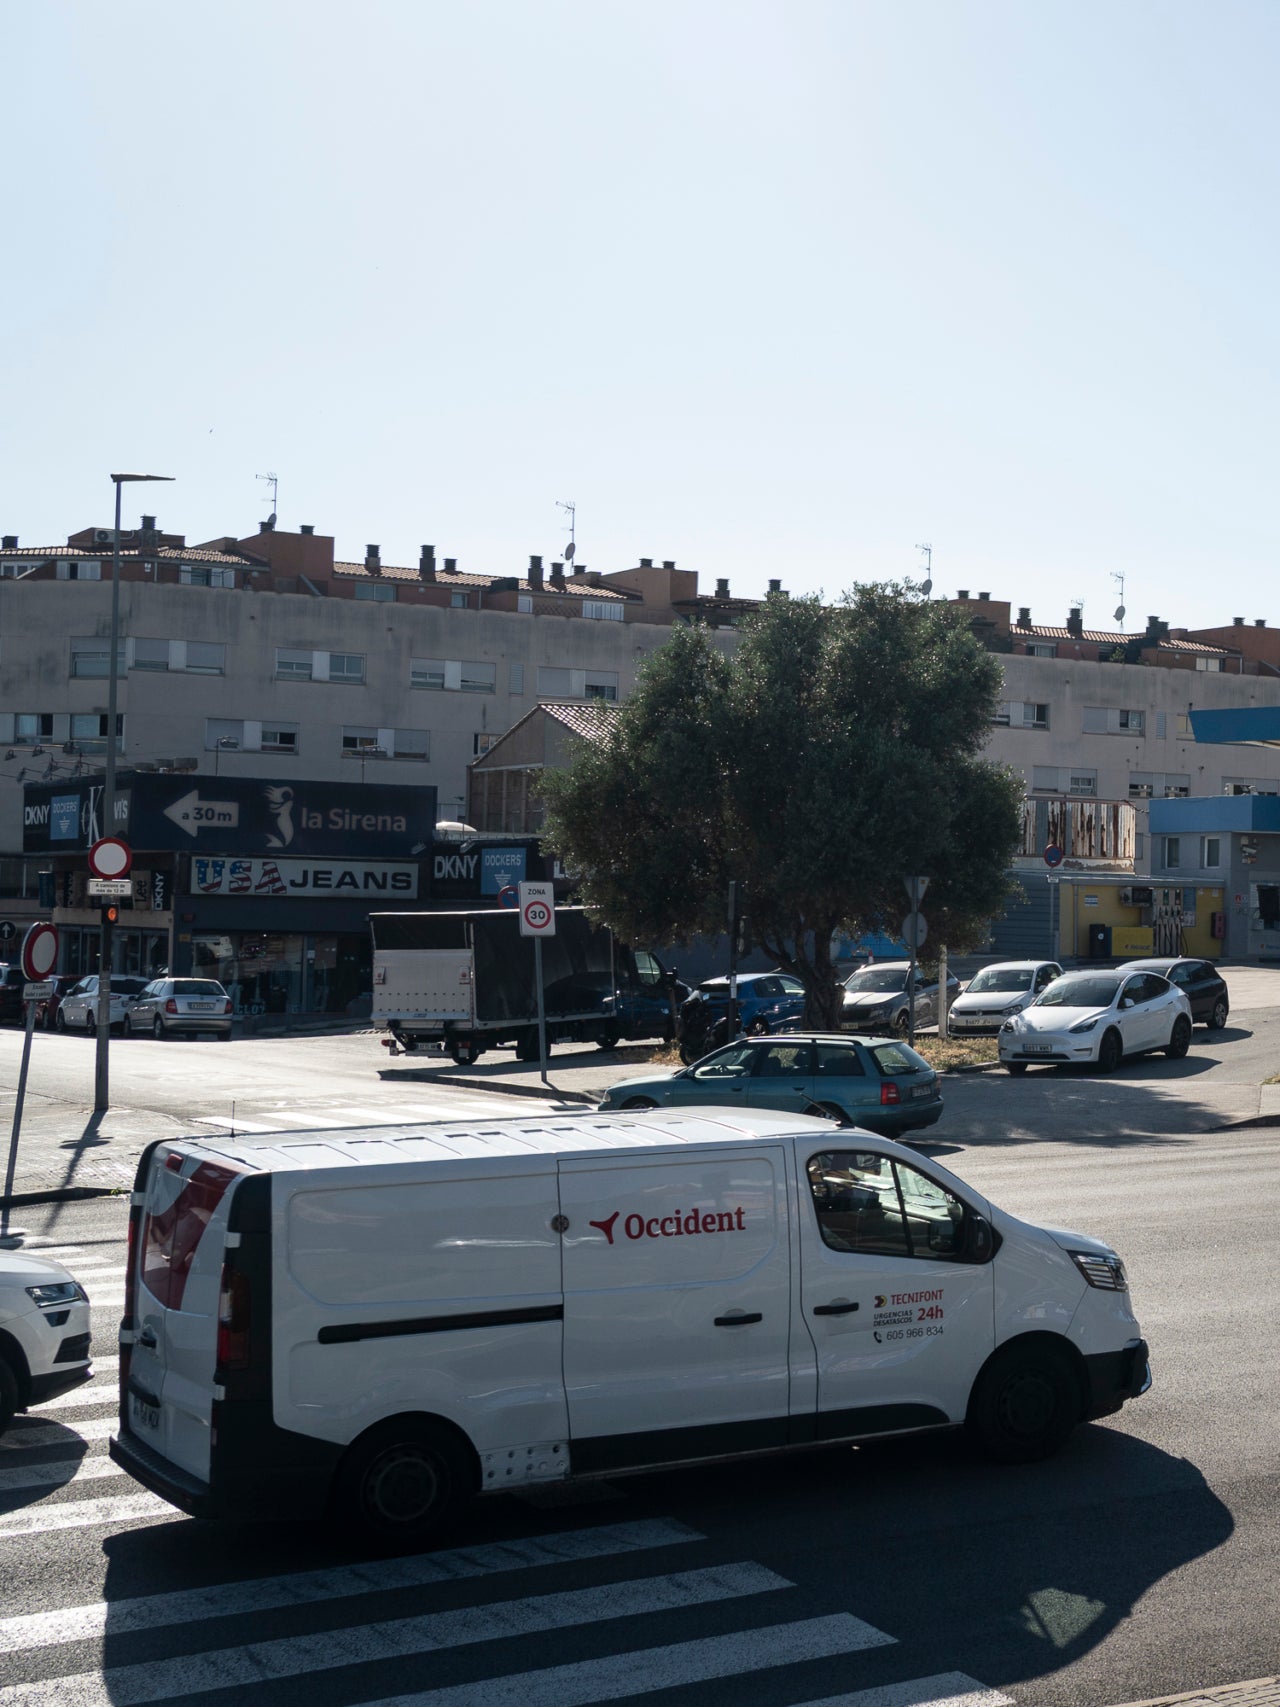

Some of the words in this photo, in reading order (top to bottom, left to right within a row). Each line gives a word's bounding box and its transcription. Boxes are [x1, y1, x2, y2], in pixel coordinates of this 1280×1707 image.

[25, 805, 50, 825] DKNY
[182, 811, 191, 820] a
[193, 807, 215, 821] 30
[218, 811, 233, 821] m
[302, 808, 323, 829] la
[328, 810, 408, 833] Sirena
[434, 855, 480, 880] DKNY
[485, 854, 523, 866] DOCKERS
[195, 860, 287, 894] USA
[290, 869, 413, 892] JEANS
[155, 872, 166, 911] DKNY
[528, 888, 546, 896] ZONA
[530, 910, 546, 921] 30
[625, 1206, 746, 1240] Occident
[891, 1289, 944, 1306] TECNIFONT
[873, 1309, 913, 1320] URGENCIAS
[917, 1305, 944, 1321] 24h
[873, 1317, 913, 1327] DESATASCOS
[886, 1329, 904, 1340] 605
[906, 1327, 924, 1338] 966
[926, 1326, 944, 1337] 834
